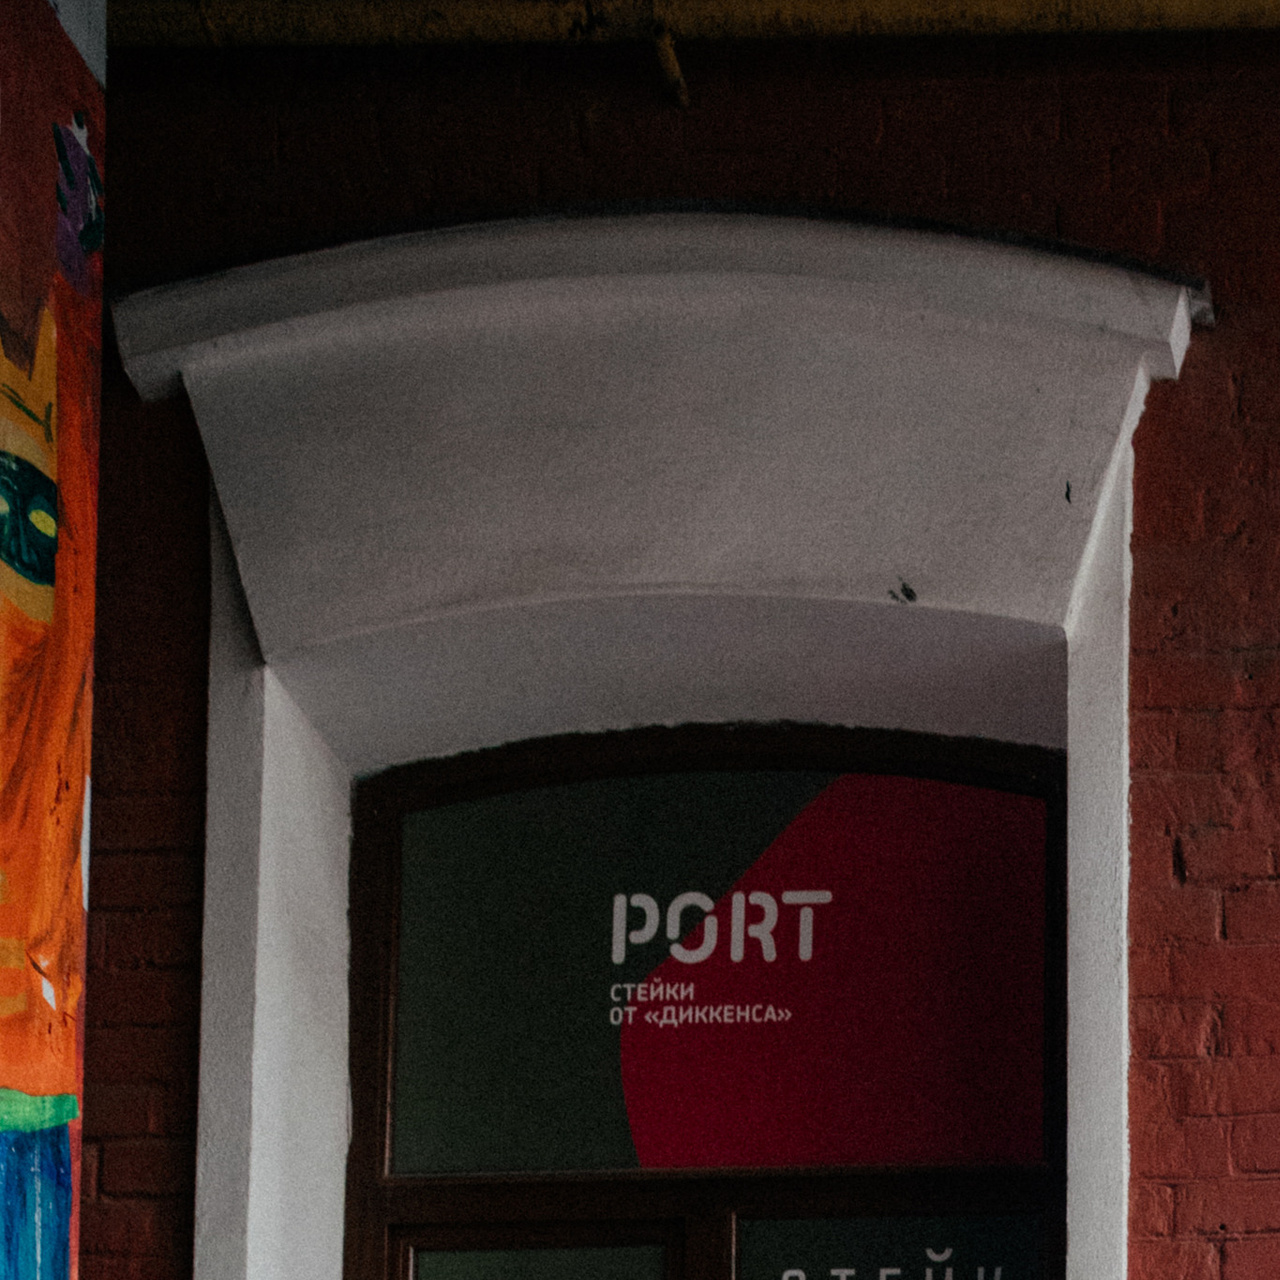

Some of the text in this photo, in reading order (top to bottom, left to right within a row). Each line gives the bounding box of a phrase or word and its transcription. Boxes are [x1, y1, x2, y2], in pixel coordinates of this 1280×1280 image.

[611, 890, 834, 965] PORT
[610, 977, 695, 1002] СТЕЙКИ
[610, 1004, 793, 1028] ОТ «ДИККЕНСА»
